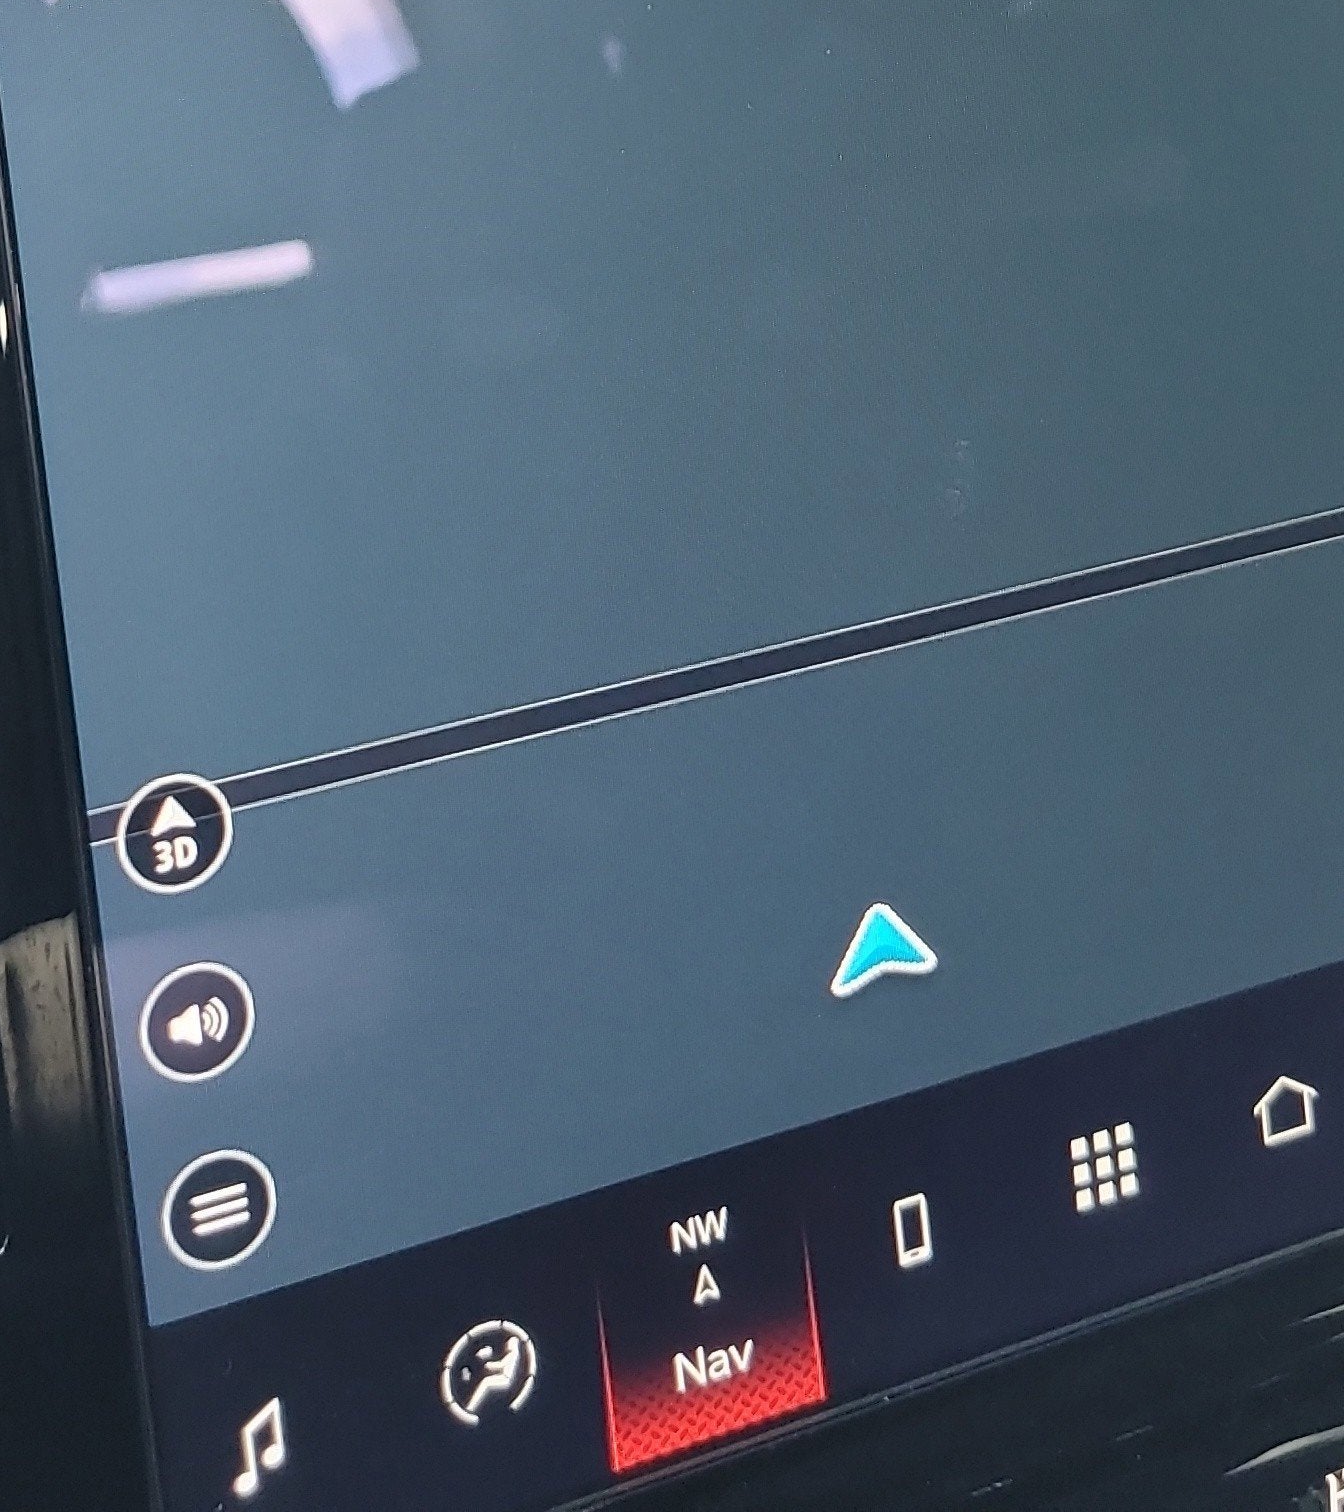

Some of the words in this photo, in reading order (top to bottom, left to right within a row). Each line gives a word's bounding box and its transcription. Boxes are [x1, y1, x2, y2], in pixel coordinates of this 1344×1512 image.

[154, 835, 198, 874] 3D
[670, 1205, 729, 1255] NW
[672, 1339, 754, 1393] Nav
